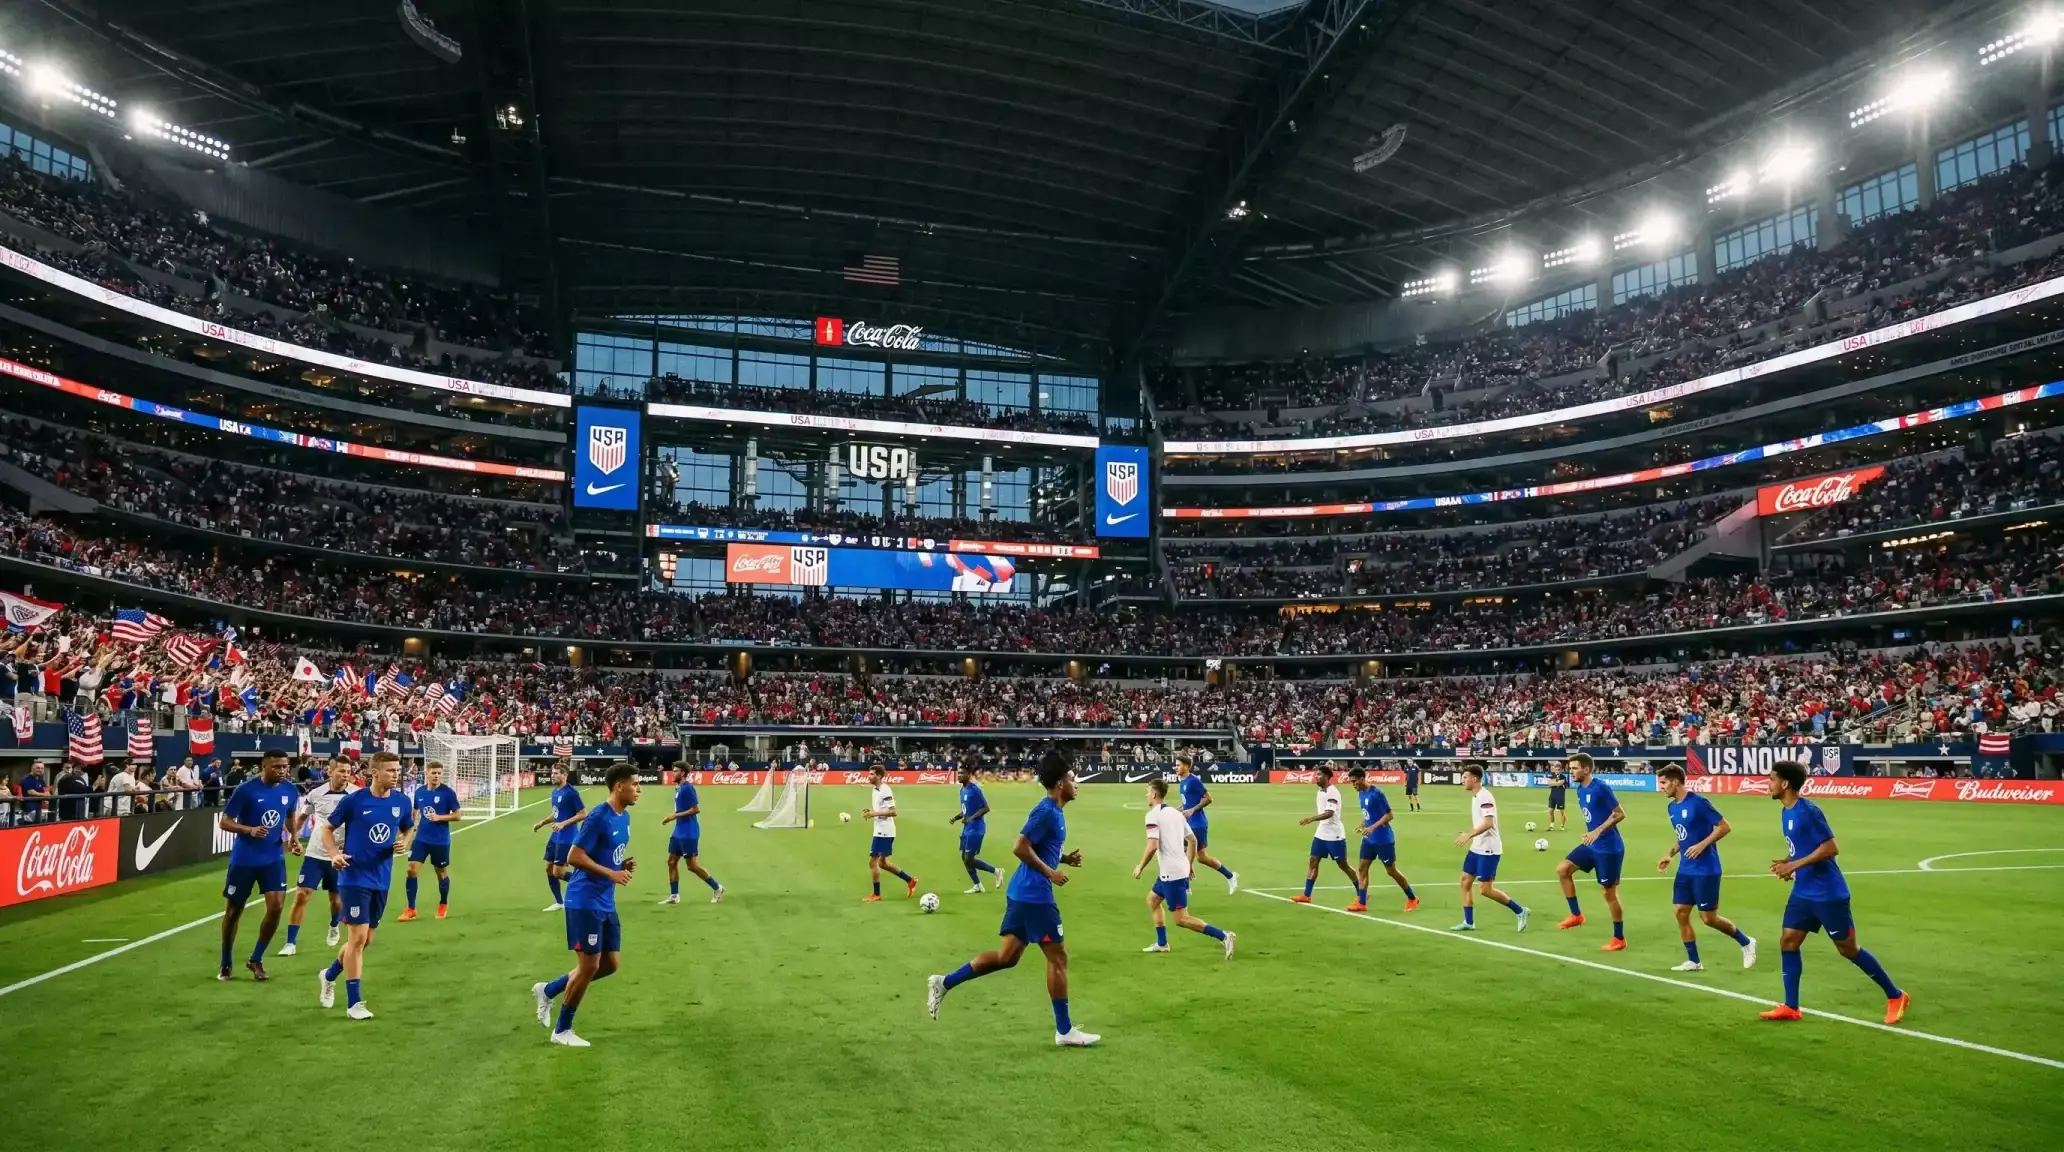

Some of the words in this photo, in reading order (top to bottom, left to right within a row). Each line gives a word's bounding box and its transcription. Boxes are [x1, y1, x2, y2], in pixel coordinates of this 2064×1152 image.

[202, 322, 225, 338] USA
[847, 321, 923, 350] Coca-Cola
[1843, 335, 1867, 350] USA
[448, 379, 470, 391] USA
[1627, 395, 1646, 407] USA
[791, 416, 810, 425] USA
[593, 429, 624, 446] USA
[1415, 430, 1434, 439] USA
[850, 445, 908, 478] USA
[1110, 464, 1135, 479] USA
[1775, 474, 1856, 512] Coca-Cola
[794, 549, 825, 567] USA
[1824, 748, 1838, 758] USA
[1955, 780, 2054, 800] Budweiser
[17, 825, 99, 896] Coca-Cola
